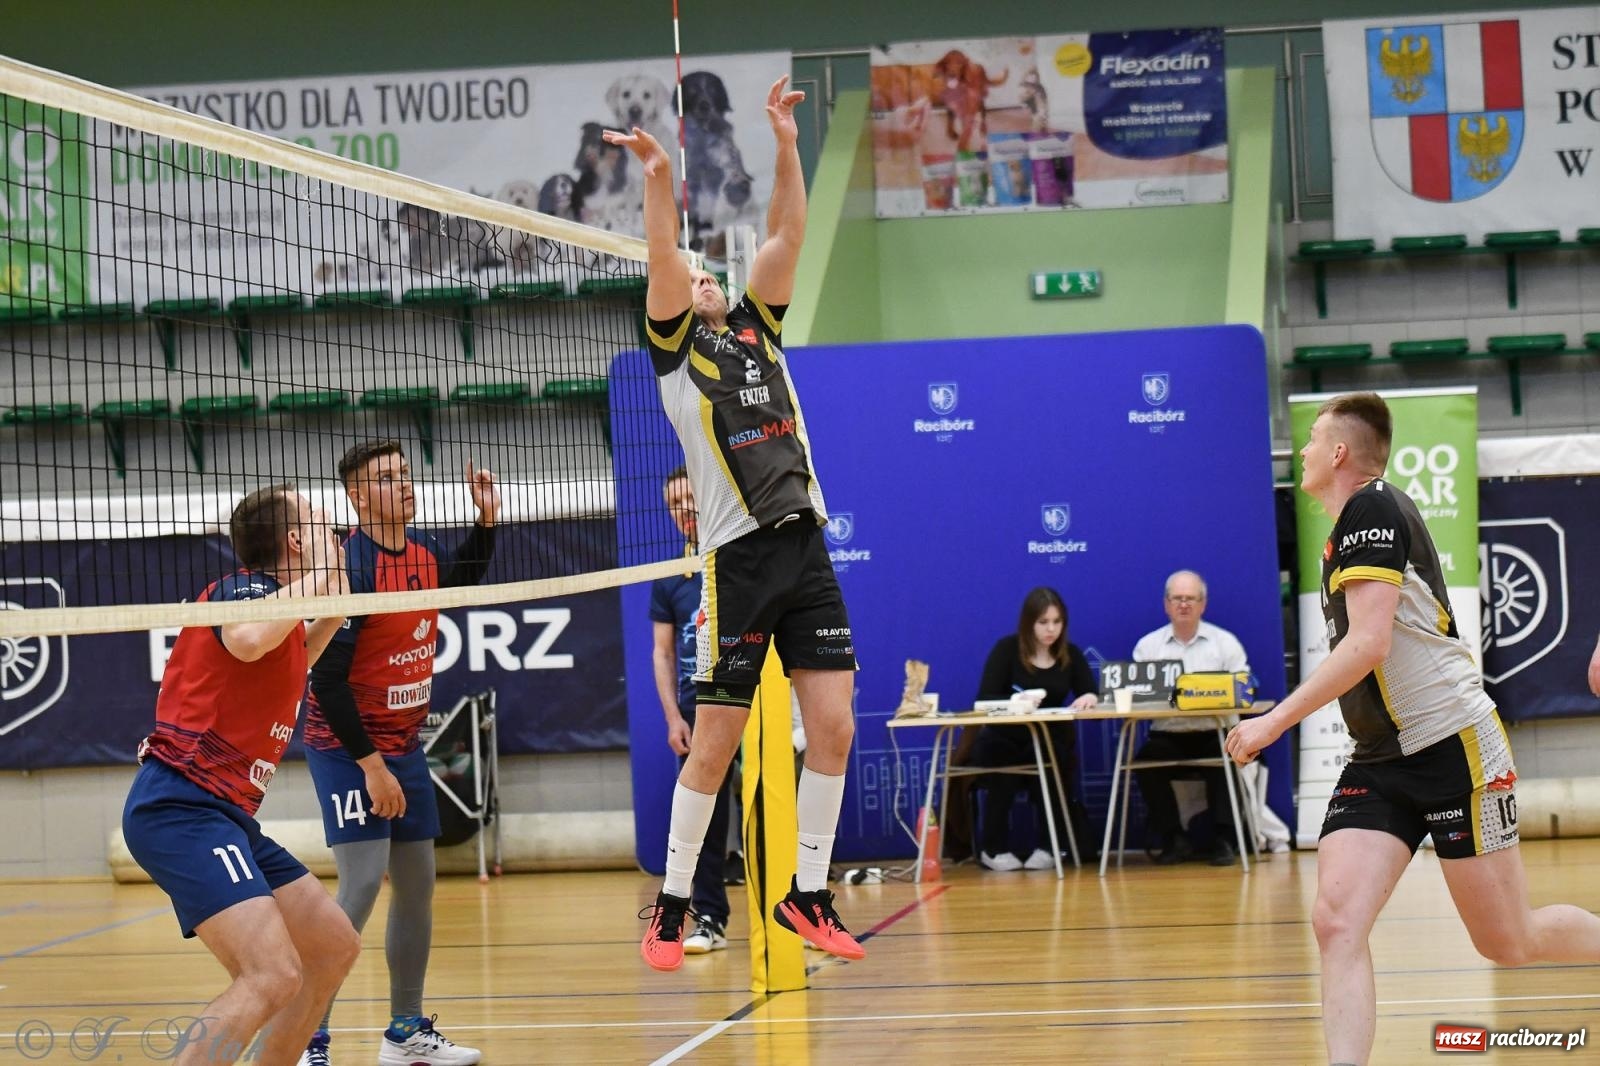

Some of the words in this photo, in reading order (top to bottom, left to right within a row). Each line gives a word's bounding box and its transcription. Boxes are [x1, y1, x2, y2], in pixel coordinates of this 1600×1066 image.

[1100, 52, 1210, 76] Flexadin
[301, 88, 364, 129] DLA
[374, 77, 530, 125] TWOJEGO
[1556, 149, 1593, 178] W
[739, 385, 770, 407] ENTER
[914, 418, 975, 433] Racibórz
[1128, 409, 1185, 424] Racibórz
[728, 418, 796, 447] INSTALMAG
[1389, 443, 1460, 479] OO
[829, 548, 871, 563] cibórz
[1027, 539, 1088, 555] Racibórz
[1102, 665, 1122, 688] 13
[1128, 663, 1138, 681] 0
[1146, 663, 1156, 681] 0
[1161, 662, 1181, 688] 10
[331, 789, 367, 829] 14
[1497, 793, 1517, 830] 10
[212, 844, 254, 884] 11
